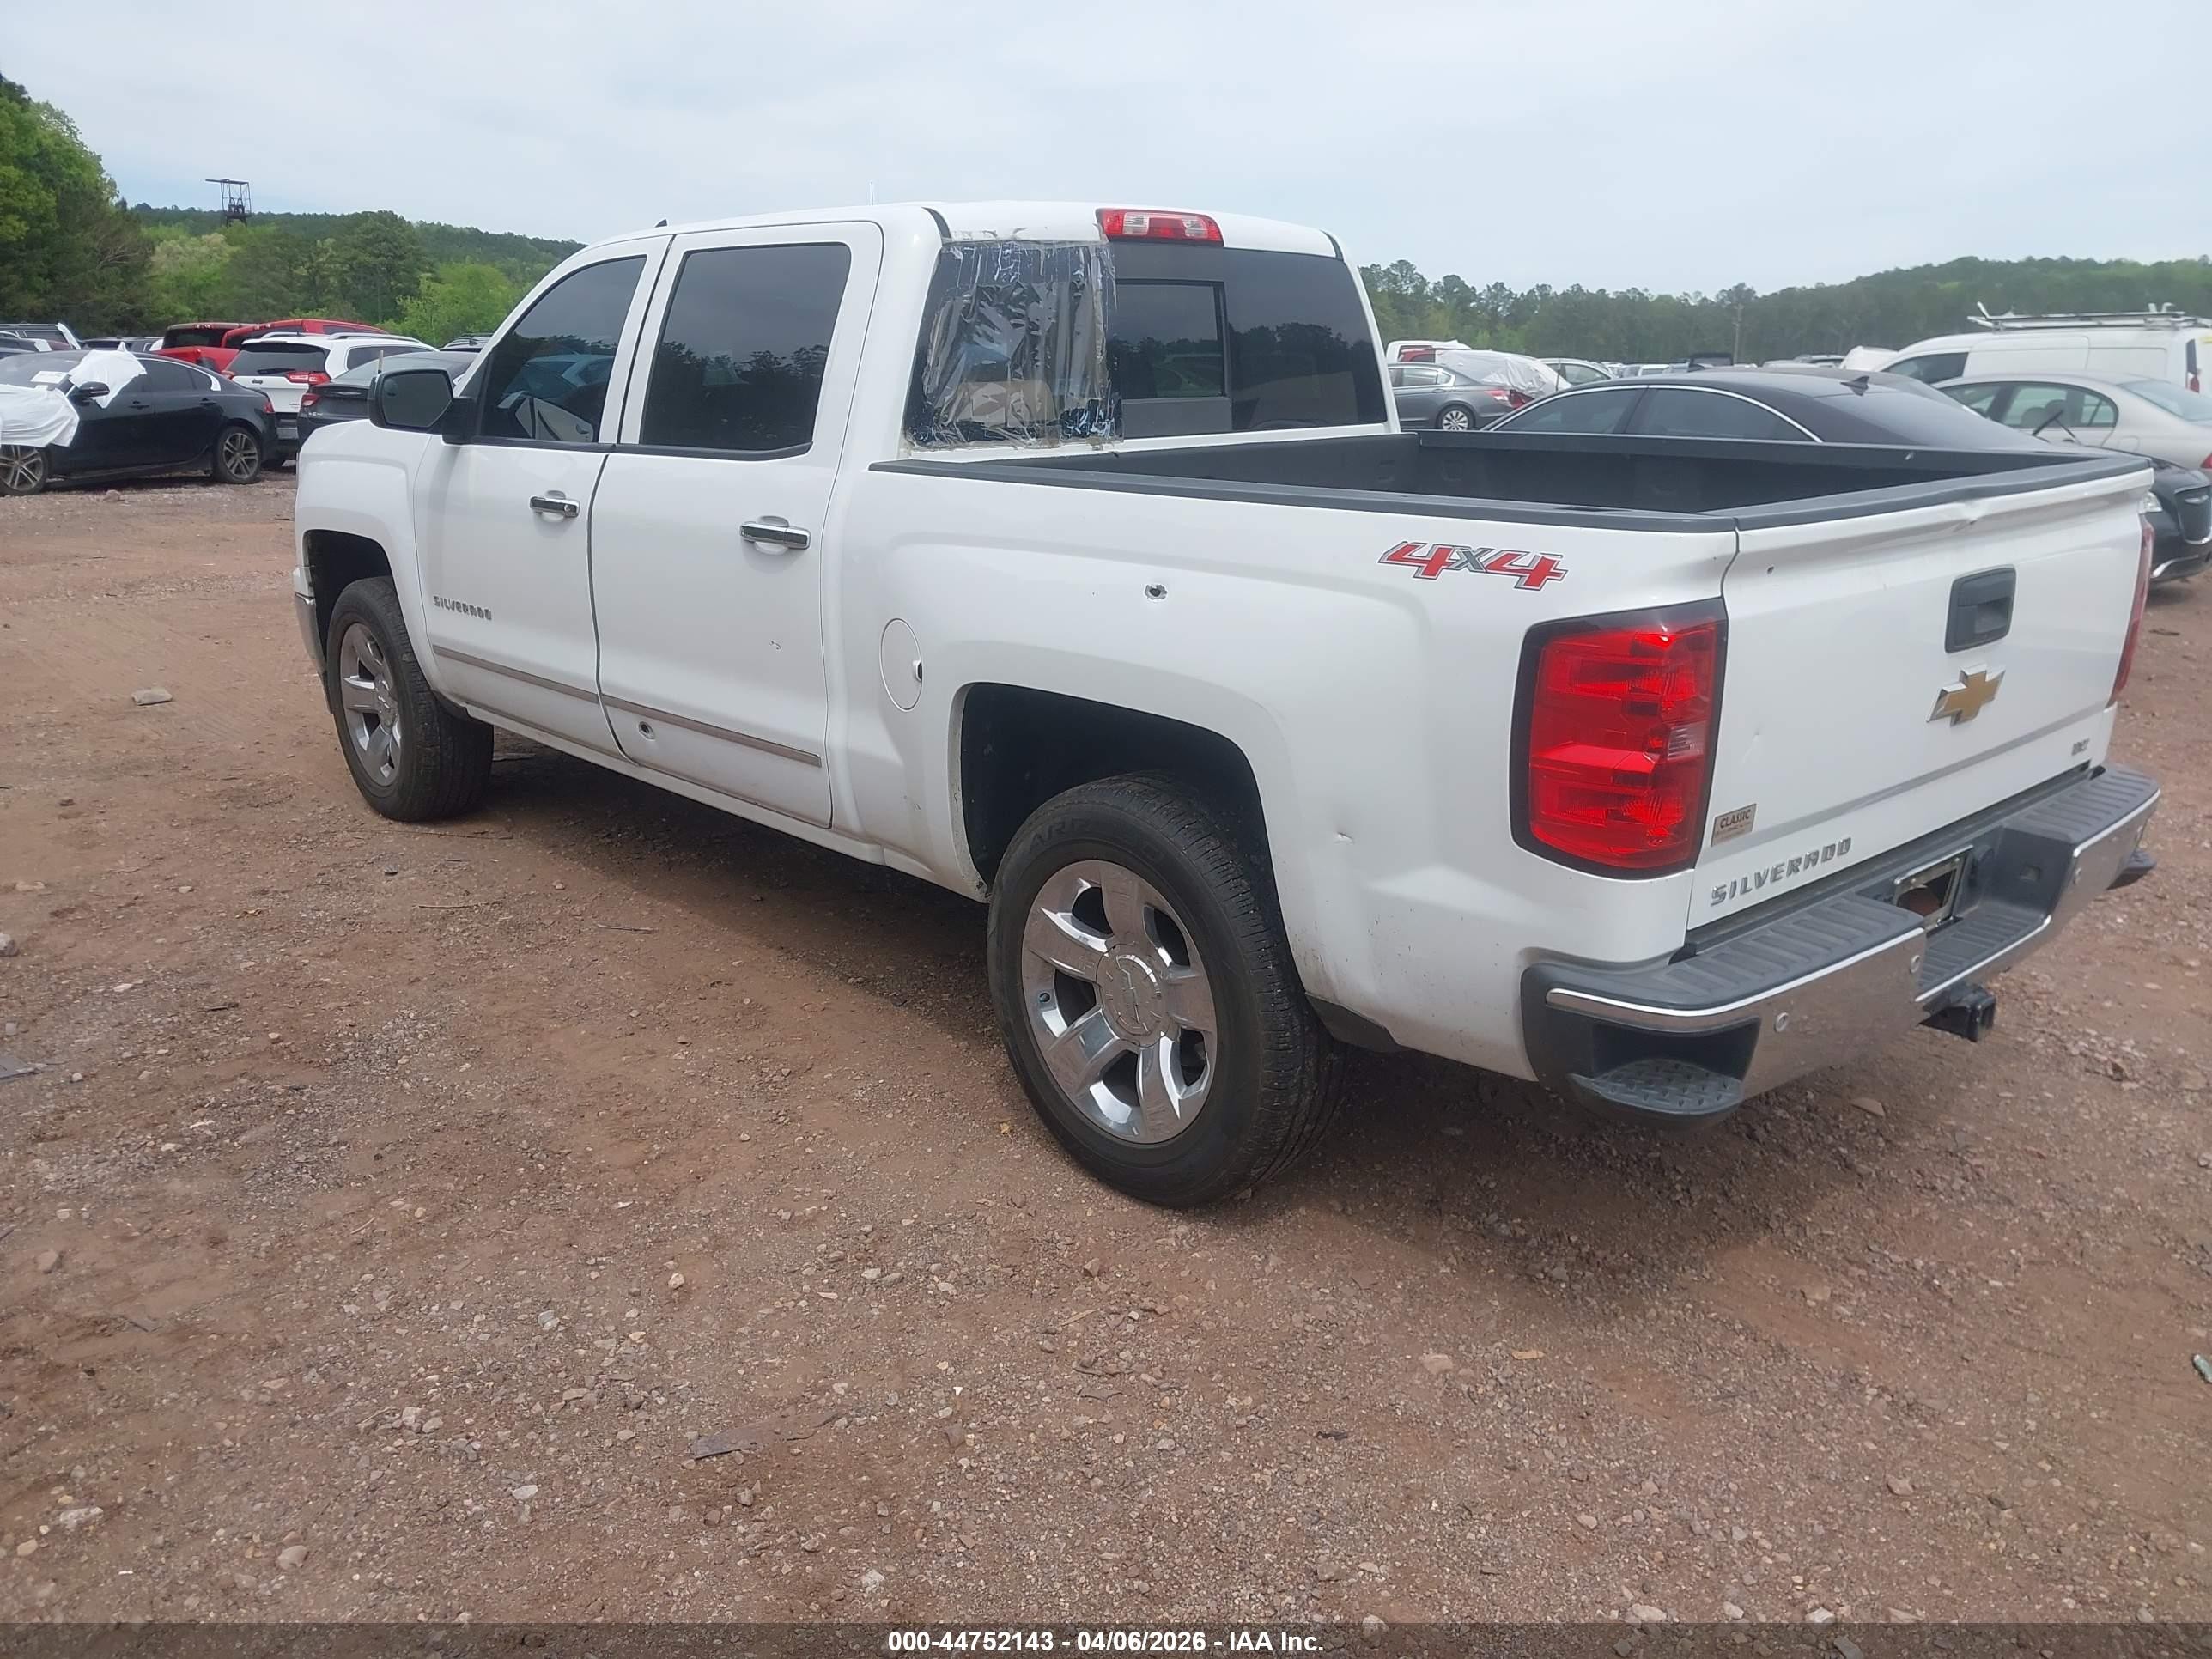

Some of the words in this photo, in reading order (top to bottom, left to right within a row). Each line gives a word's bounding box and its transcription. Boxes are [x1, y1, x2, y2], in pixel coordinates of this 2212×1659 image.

[433, 595, 492, 620] SILVERADO
[1720, 809, 1751, 829] CLASSIC
[1710, 837, 1851, 907] SILVERADO
